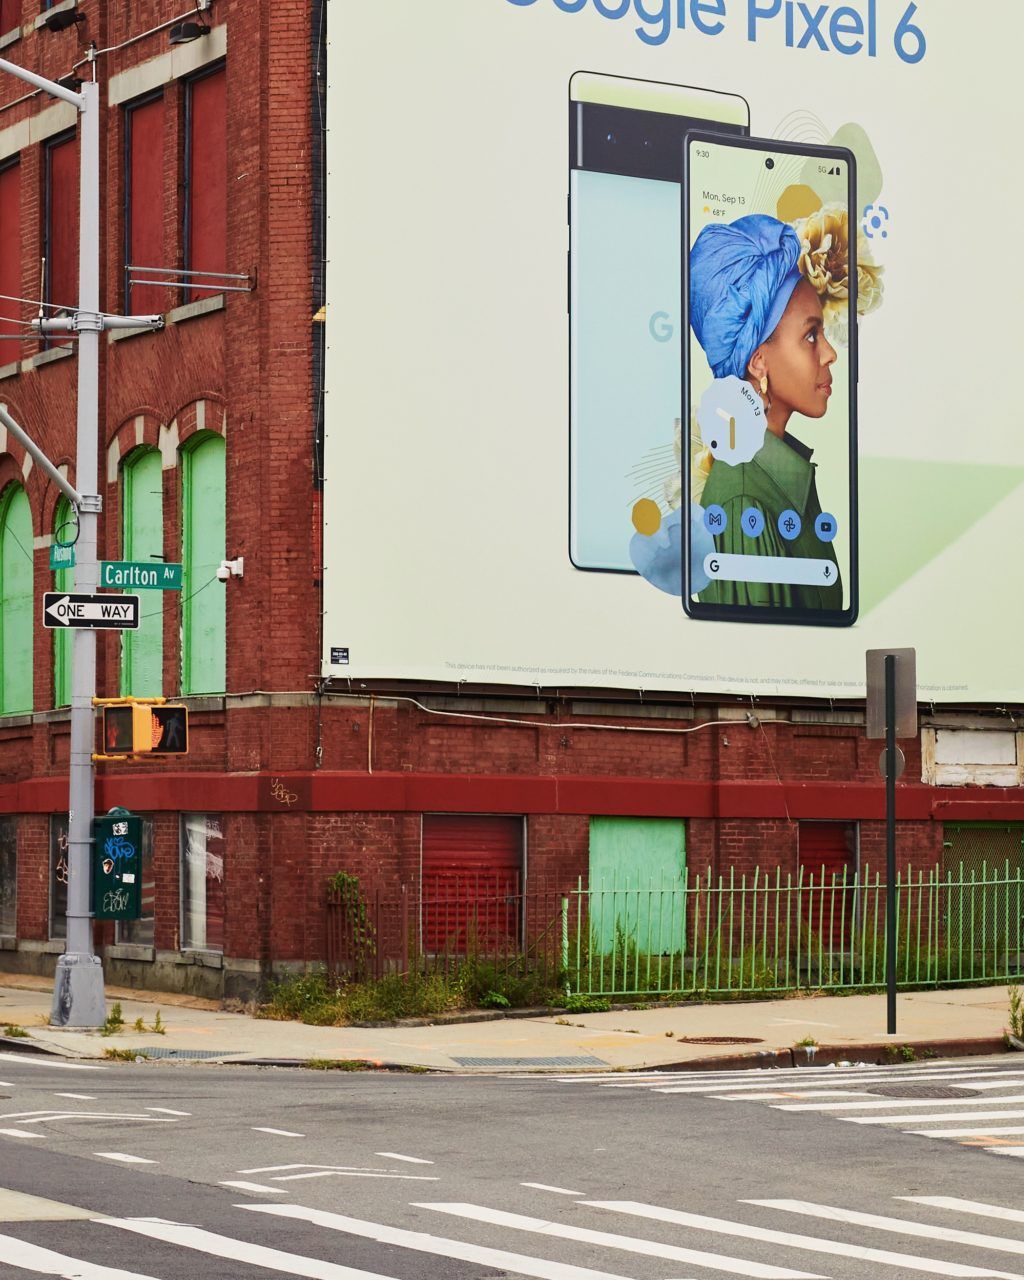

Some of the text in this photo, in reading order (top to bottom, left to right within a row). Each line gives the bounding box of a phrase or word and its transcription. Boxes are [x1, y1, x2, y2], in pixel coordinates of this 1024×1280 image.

[893, 1, 927, 65] 6
[696, 150, 710, 158] 9:30
[818, 166, 827, 174] 5G
[722, 194, 737, 205] Sep
[738, 196, 746, 205] 13
[649, 310, 674, 343] G
[741, 387, 761, 417] Mon 13
[709, 559, 720, 573] G
[106, 565, 175, 585] Carlton Av
[57, 604, 131, 618] ONE WAY
